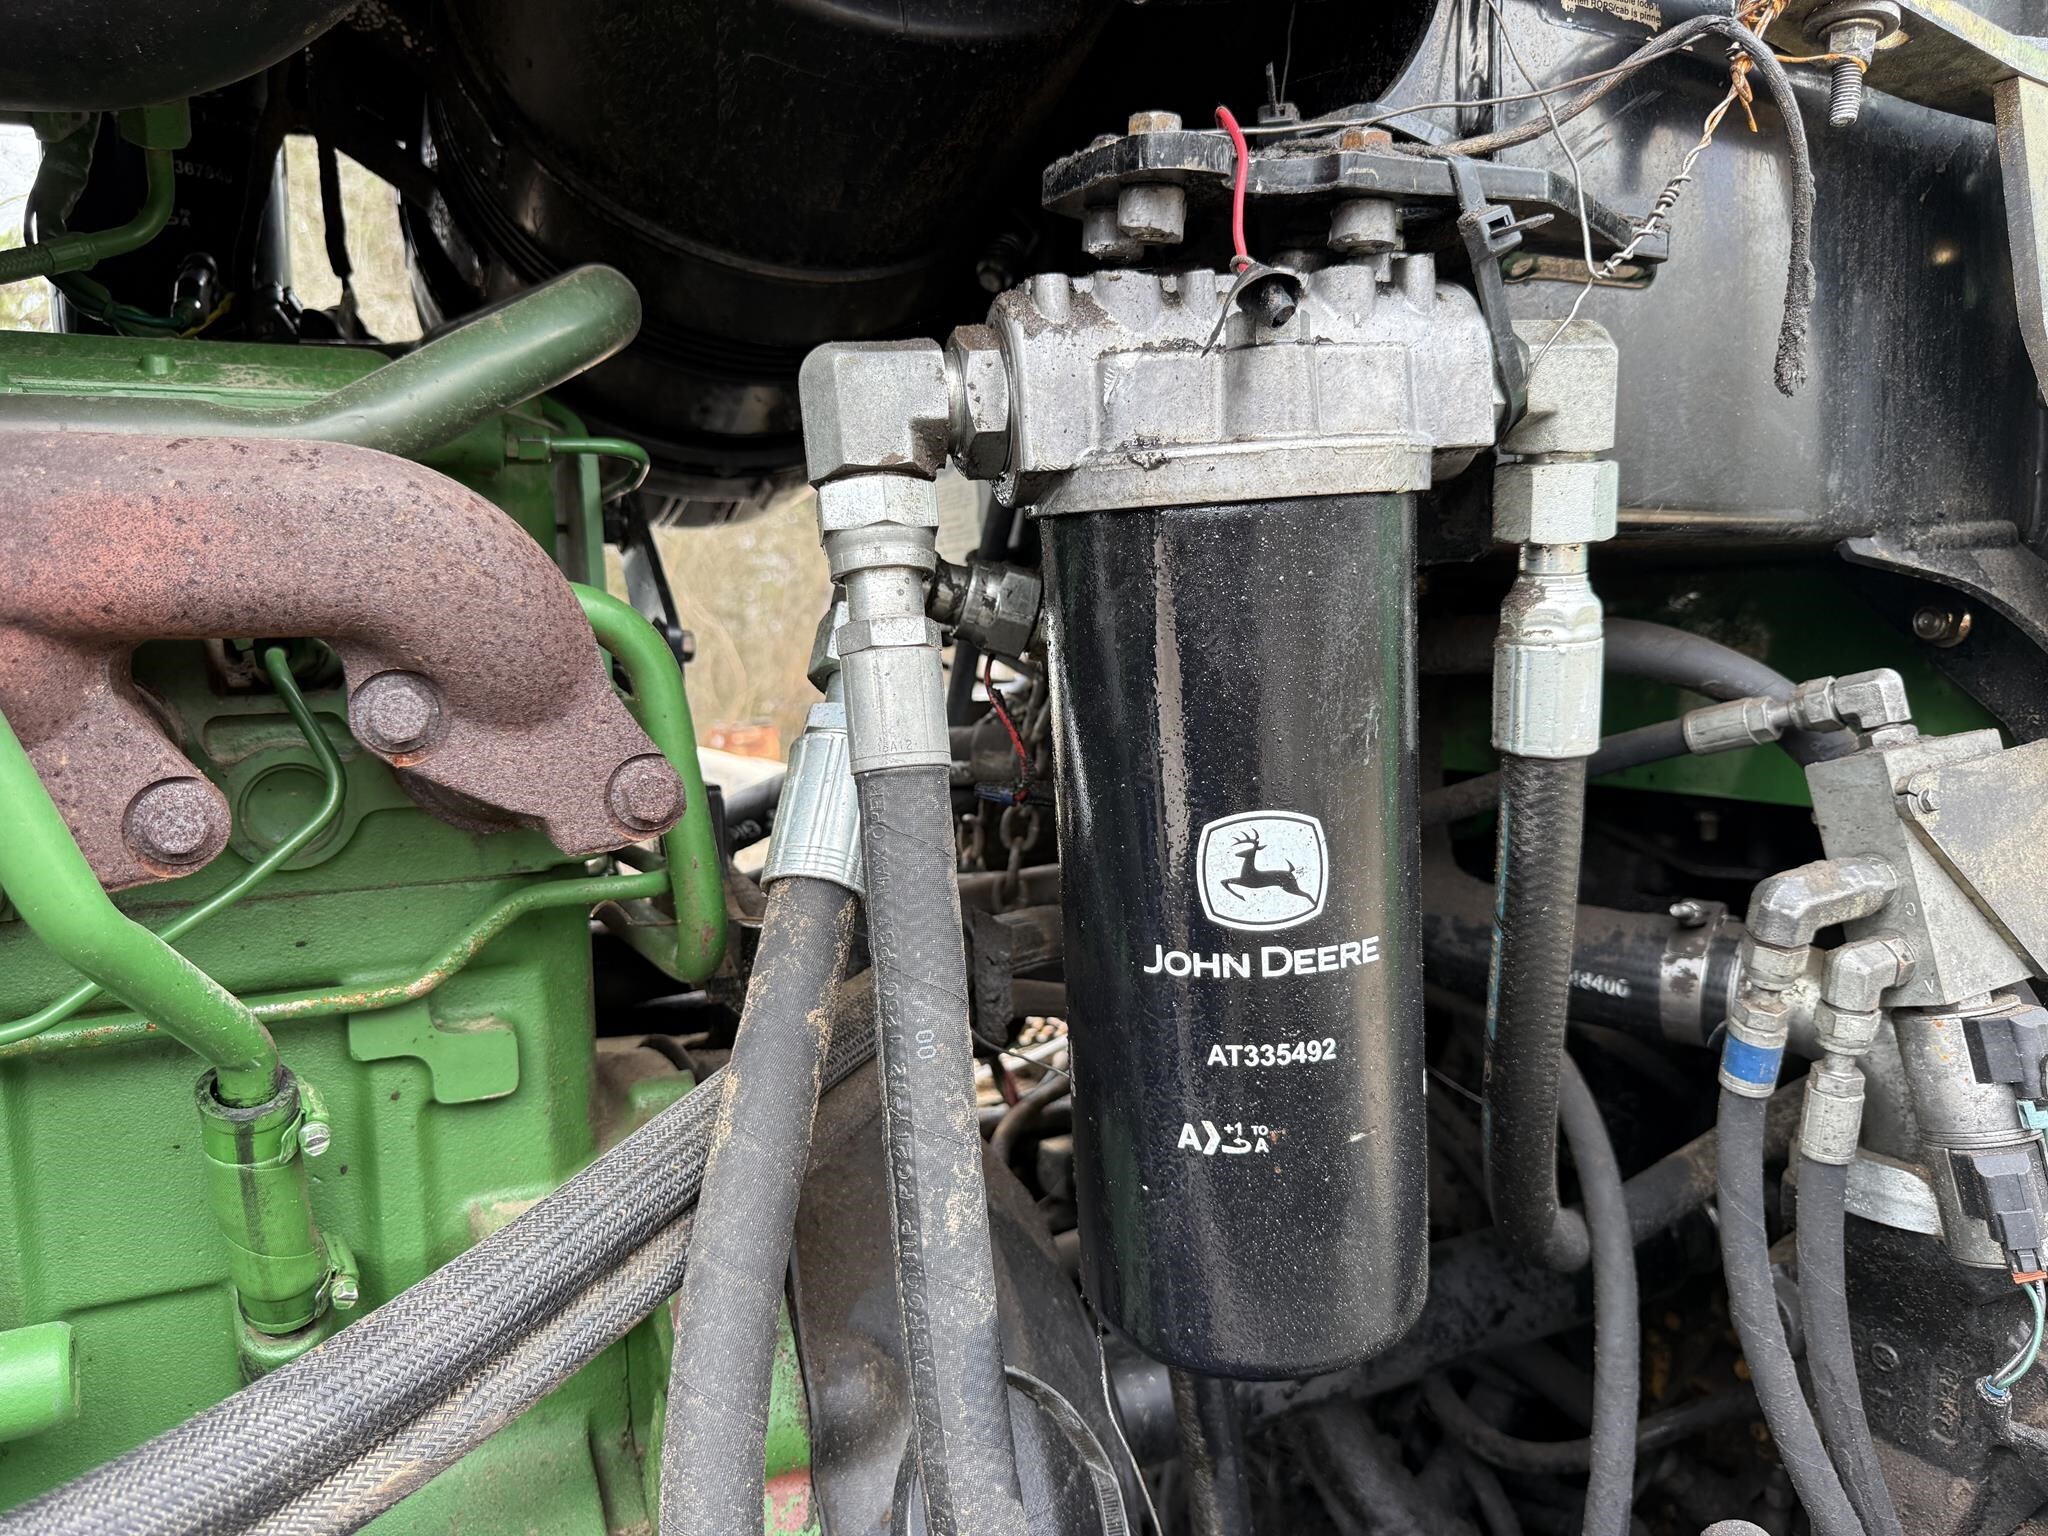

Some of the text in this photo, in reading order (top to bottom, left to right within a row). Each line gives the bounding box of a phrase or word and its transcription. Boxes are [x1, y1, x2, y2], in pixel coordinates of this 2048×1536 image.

[1631, 8, 1637, 17] is
[1640, 11, 1661, 23] pinne
[1637, 0, 1654, 11] loop
[873, 849, 892, 895] MAX
[1144, 936, 1380, 978] JOHN DEERE
[1207, 1038, 1337, 1067] AT335492
[1177, 1122, 1202, 1151] A
[1223, 1121, 1269, 1136] +1 TO
[1254, 1137, 1270, 1153] A
